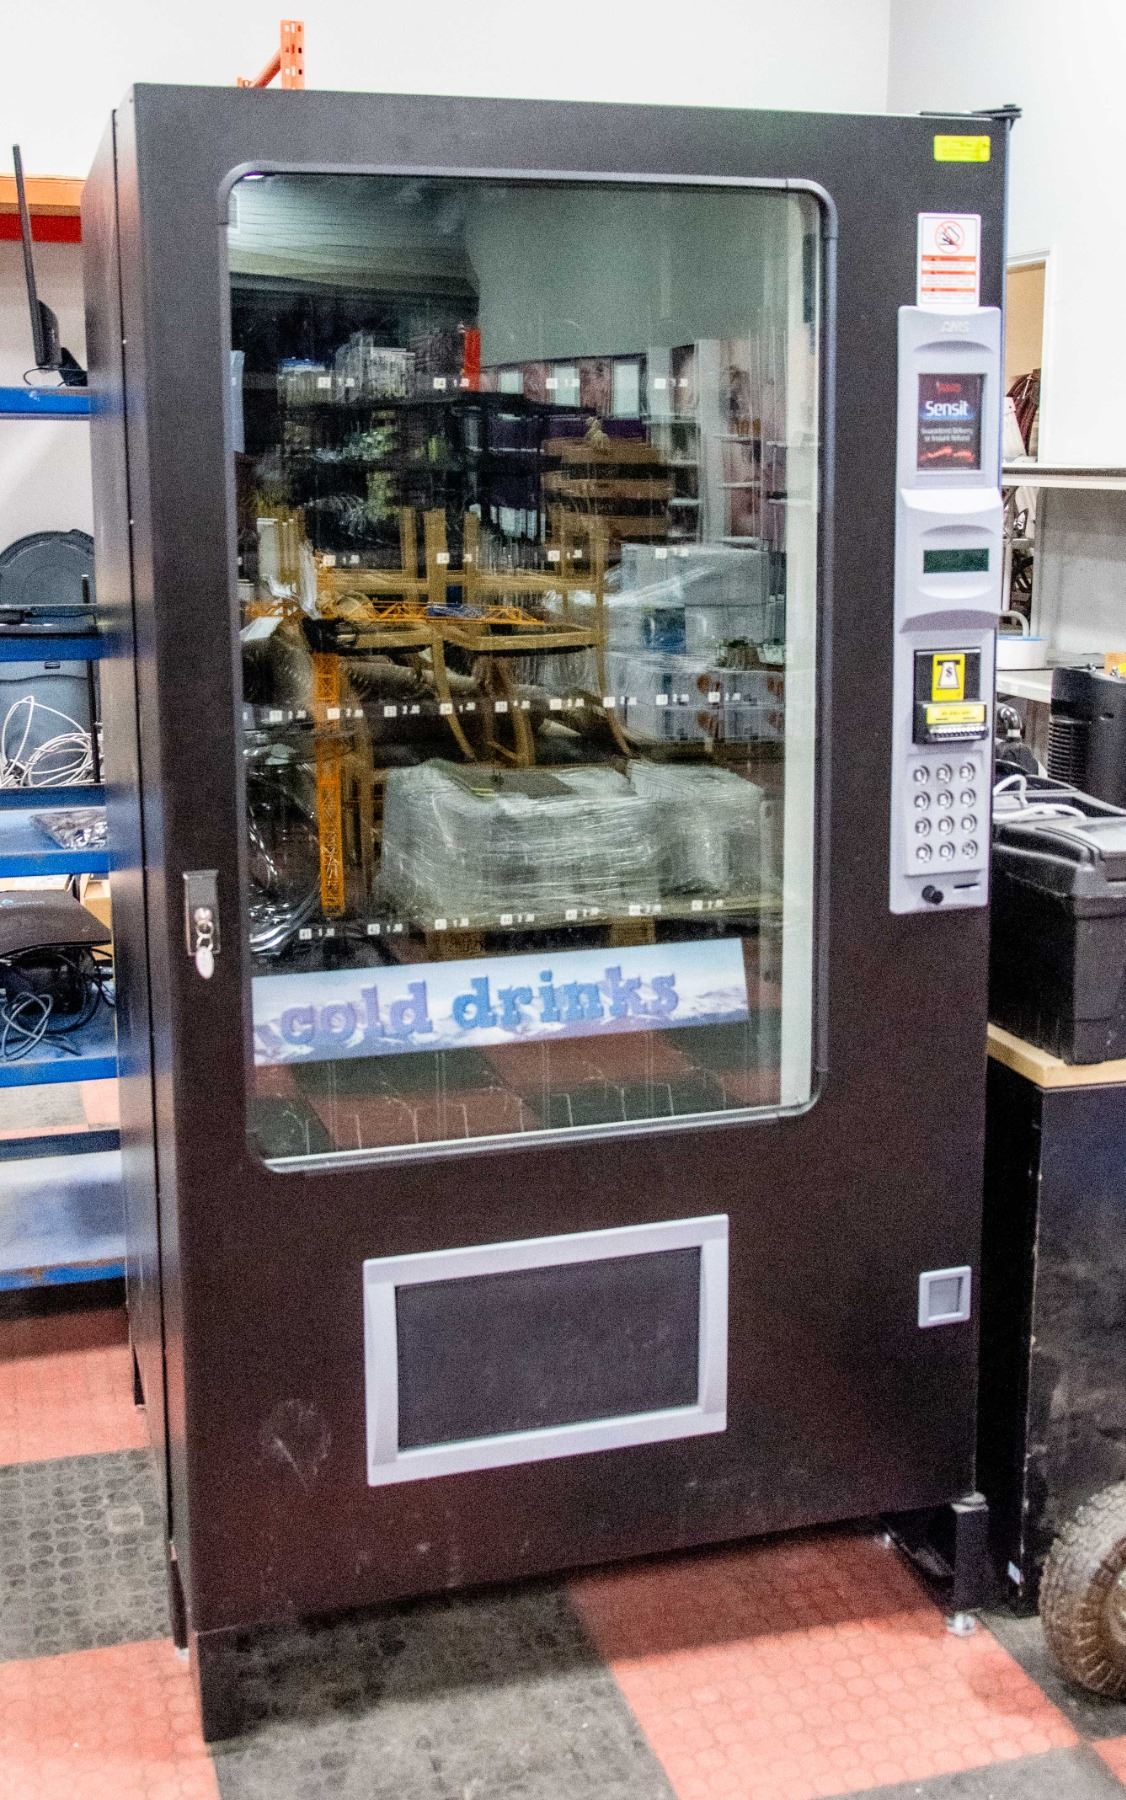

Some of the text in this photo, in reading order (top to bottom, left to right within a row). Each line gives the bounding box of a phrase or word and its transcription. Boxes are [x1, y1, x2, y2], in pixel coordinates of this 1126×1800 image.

[925, 400, 968, 416] Sensit
[280, 965, 679, 1046] cold drinks
